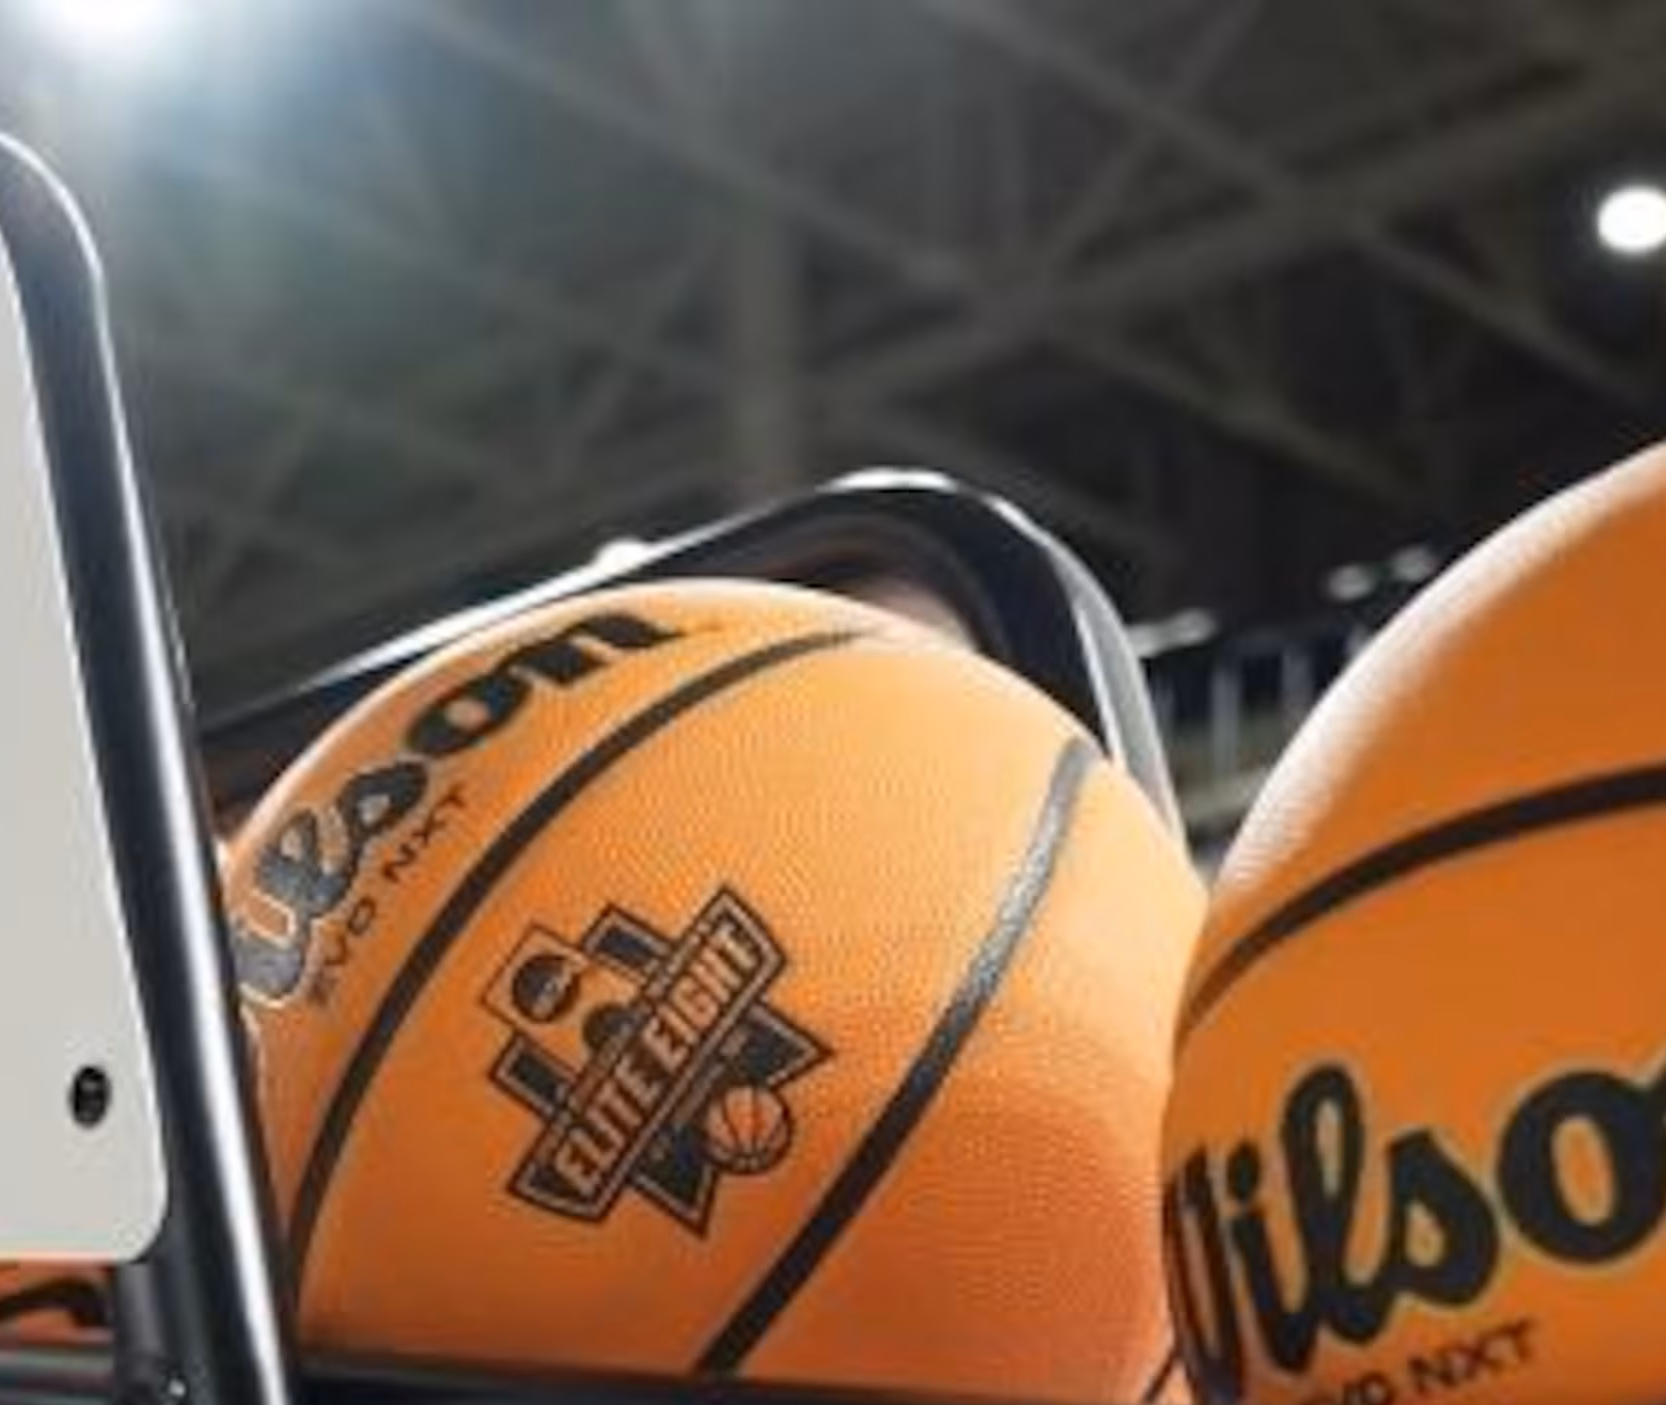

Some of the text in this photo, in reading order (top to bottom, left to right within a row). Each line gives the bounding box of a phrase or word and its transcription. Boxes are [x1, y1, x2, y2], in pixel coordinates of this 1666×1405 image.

[553, 1050, 661, 1199] ELITE
[641, 920, 759, 1070] EIGHT
[1408, 1319, 1537, 1394] NXT
